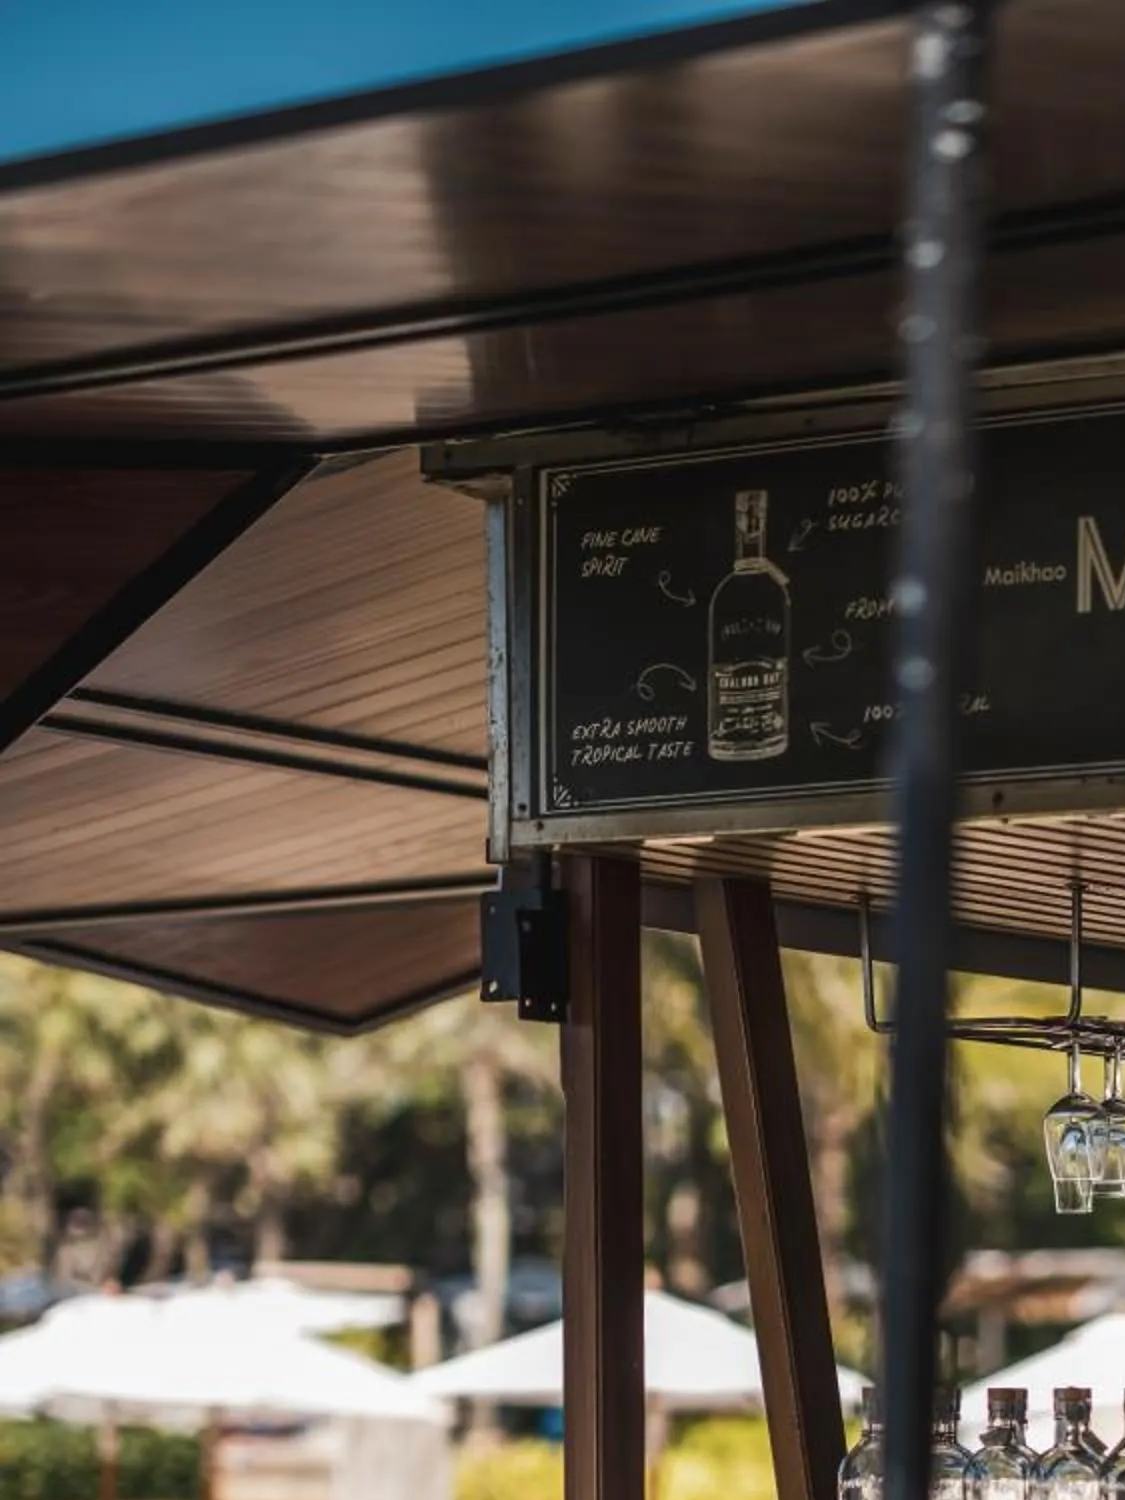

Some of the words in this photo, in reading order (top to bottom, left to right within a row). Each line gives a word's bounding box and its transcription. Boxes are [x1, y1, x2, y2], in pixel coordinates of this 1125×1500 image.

[828, 504, 903, 531] SUGARC
[580, 553, 629, 578] SPIRIT
[984, 560, 1067, 586] Maikhao
[571, 716, 621, 741] EXTRA
[626, 713, 688, 738] SMOOTH
[571, 743, 643, 767] TROPICAL
[647, 740, 697, 761] TASTE
